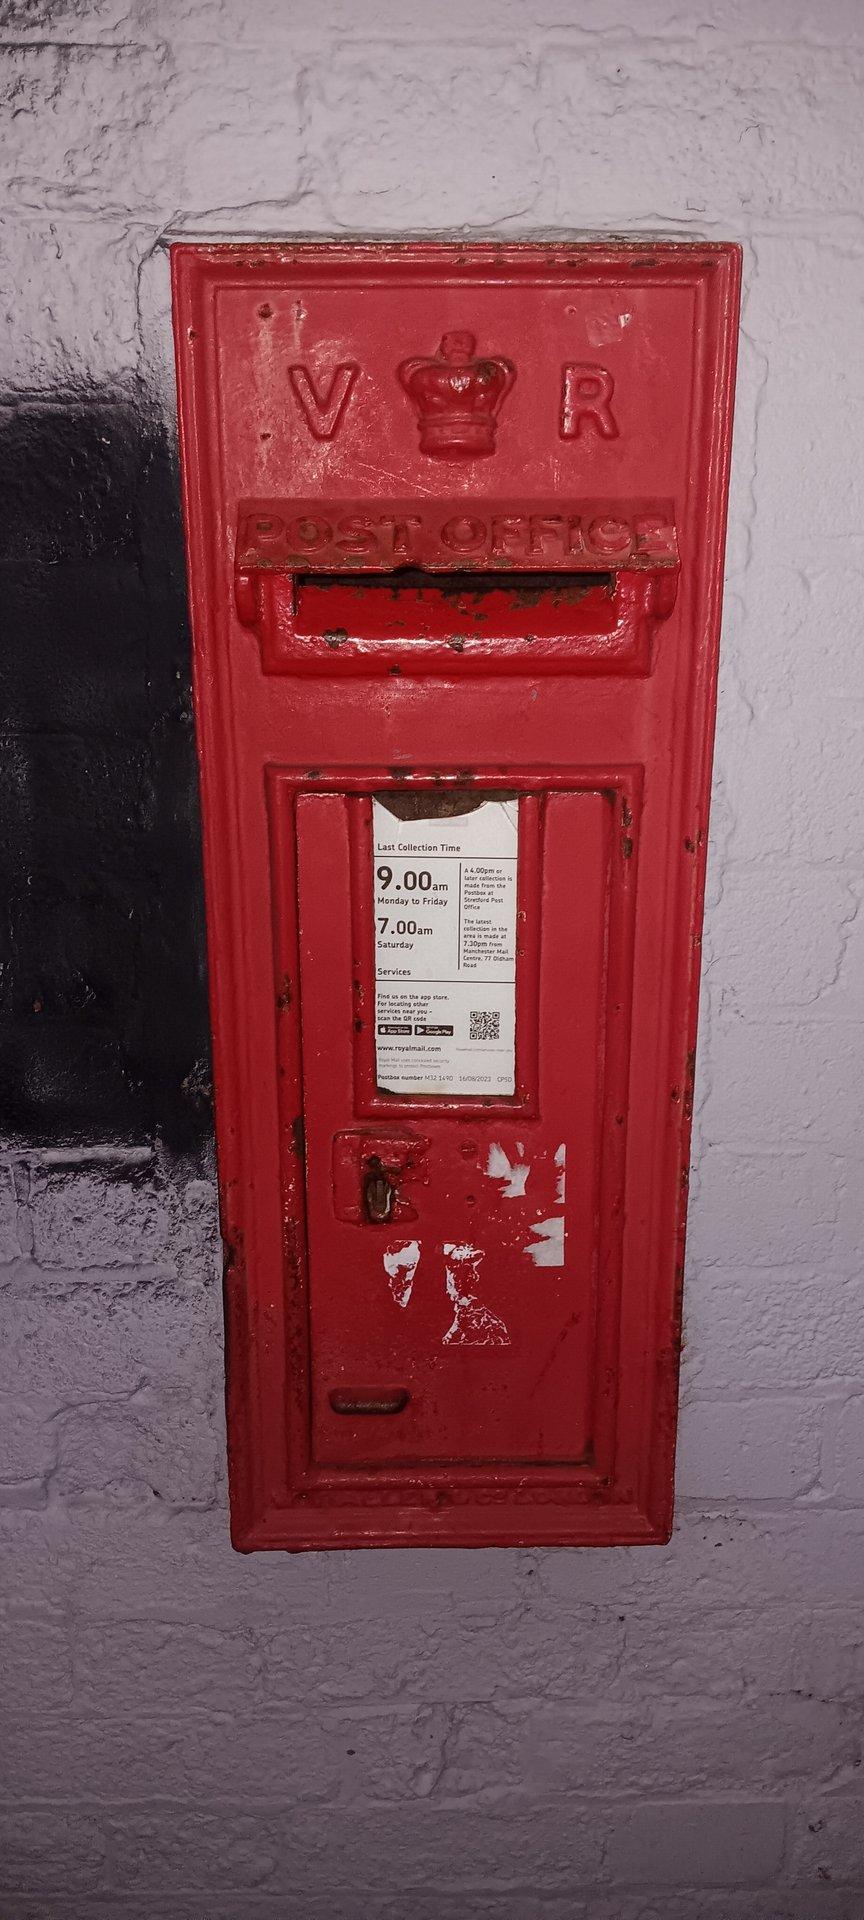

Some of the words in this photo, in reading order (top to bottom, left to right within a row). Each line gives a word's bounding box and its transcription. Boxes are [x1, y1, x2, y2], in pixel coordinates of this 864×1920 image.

[289, 362, 358, 440] V
[560, 362, 619, 440] R
[245, 513, 422, 556] POST
[441, 514, 678, 559] OFFICE
[377, 843, 395, 851] Last
[398, 843, 438, 852] Collection
[440, 843, 461, 852] Time
[376, 866, 449, 891] 9.00am
[377, 897, 409, 906] Monday
[422, 897, 448, 907] Friday
[377, 917, 433, 935] 7.00am
[377, 941, 414, 950] Saturday
[377, 968, 411, 976] Services
